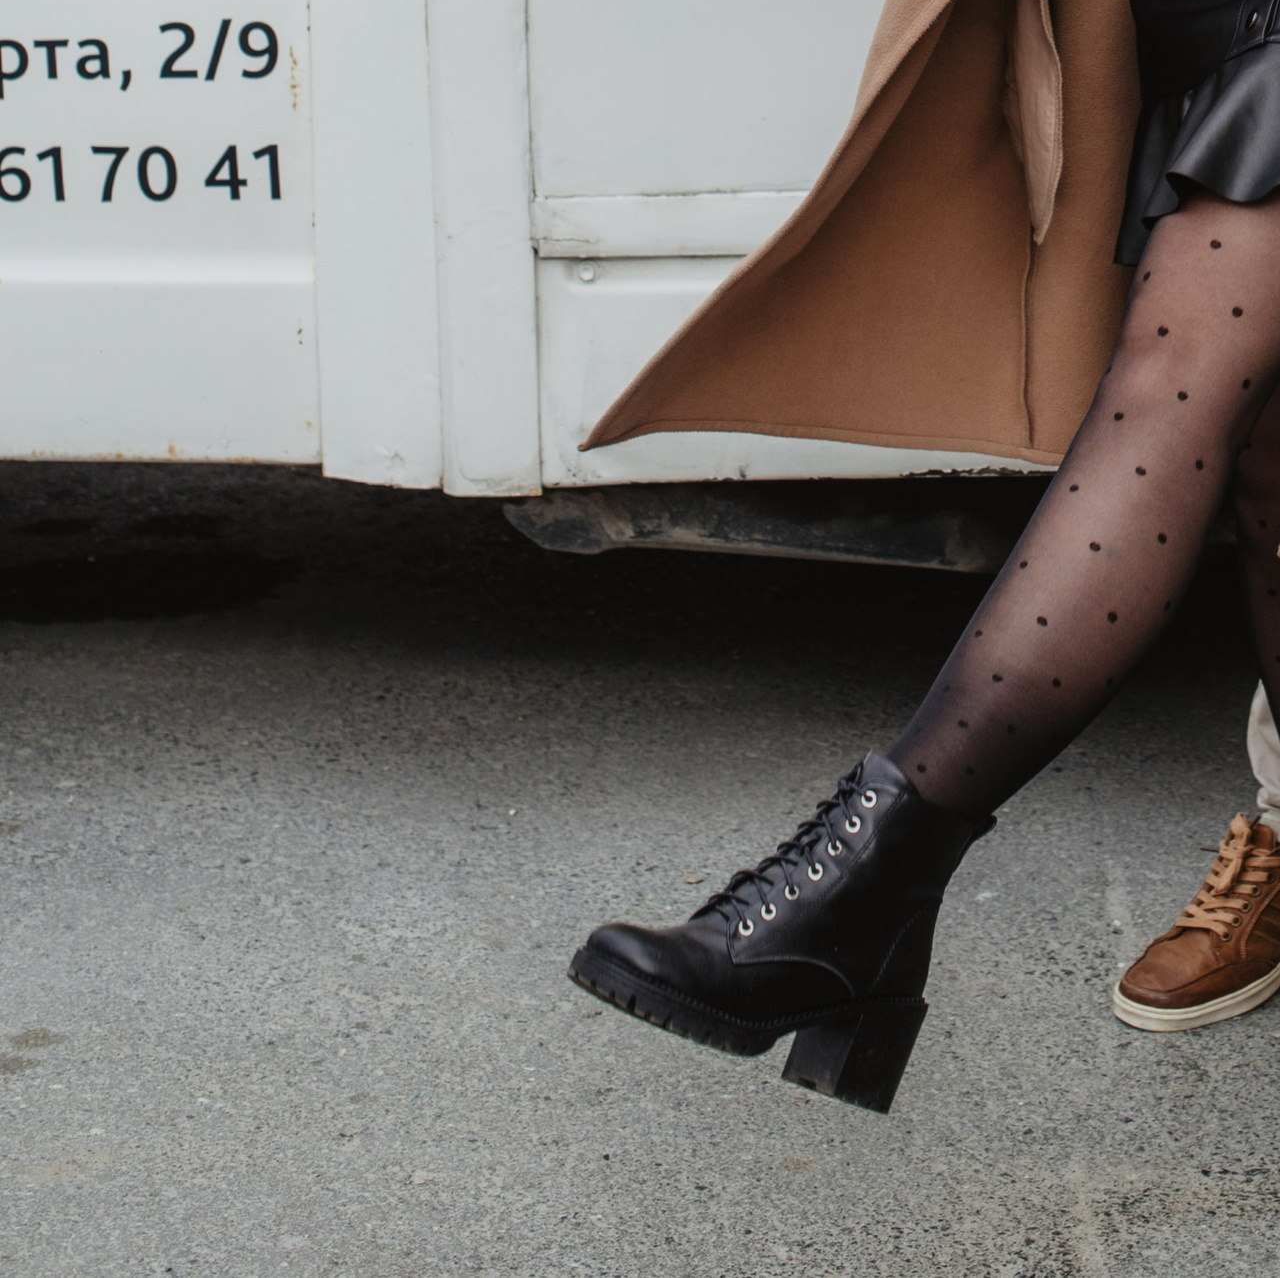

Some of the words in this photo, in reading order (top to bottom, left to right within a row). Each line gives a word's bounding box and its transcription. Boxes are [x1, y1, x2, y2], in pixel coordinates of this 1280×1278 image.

[158, 17, 279, 81] 2/9
[0, 145, 66, 203] 61
[90, 144, 178, 203] 70
[203, 144, 282, 201] 41
